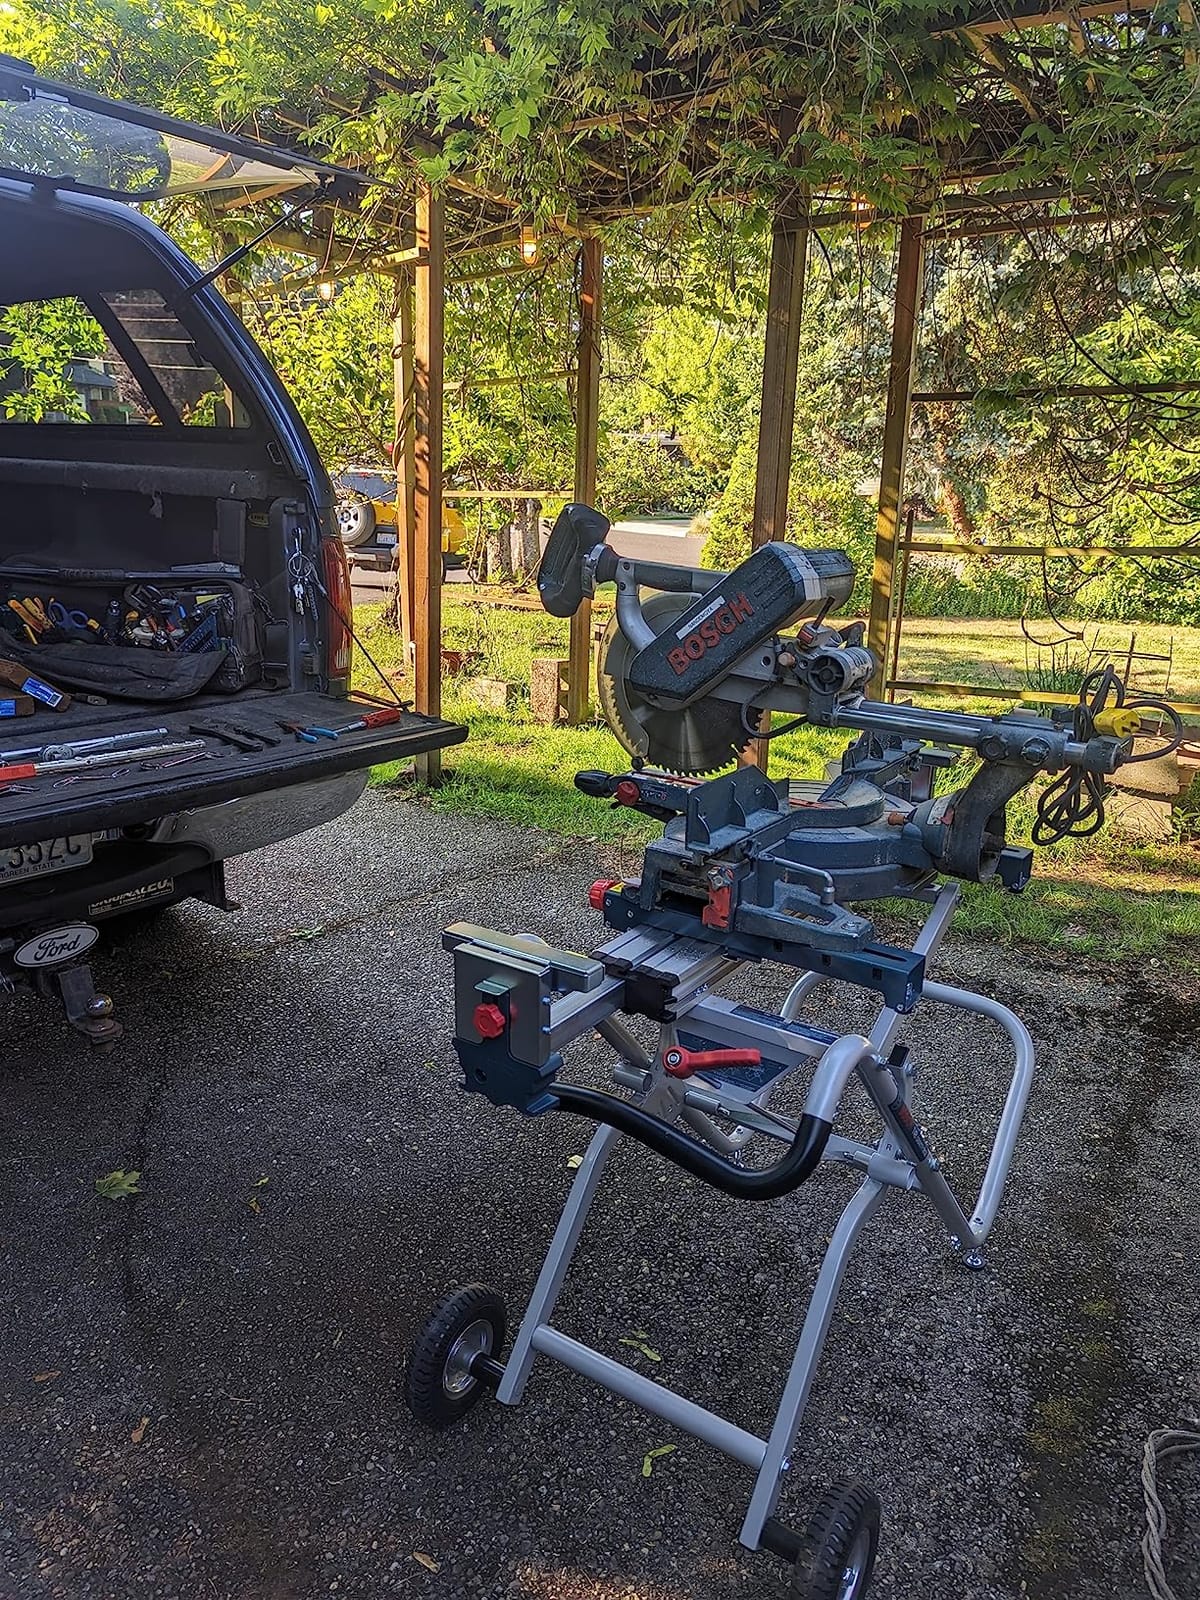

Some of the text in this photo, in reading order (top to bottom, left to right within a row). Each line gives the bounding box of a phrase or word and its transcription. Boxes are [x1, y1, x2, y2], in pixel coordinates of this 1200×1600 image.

[666, 591, 755, 676] BOSCH
[32, 861, 55, 872] STATE
[33, 933, 81, 961] Ford
[885, 1143, 893, 1151] R
